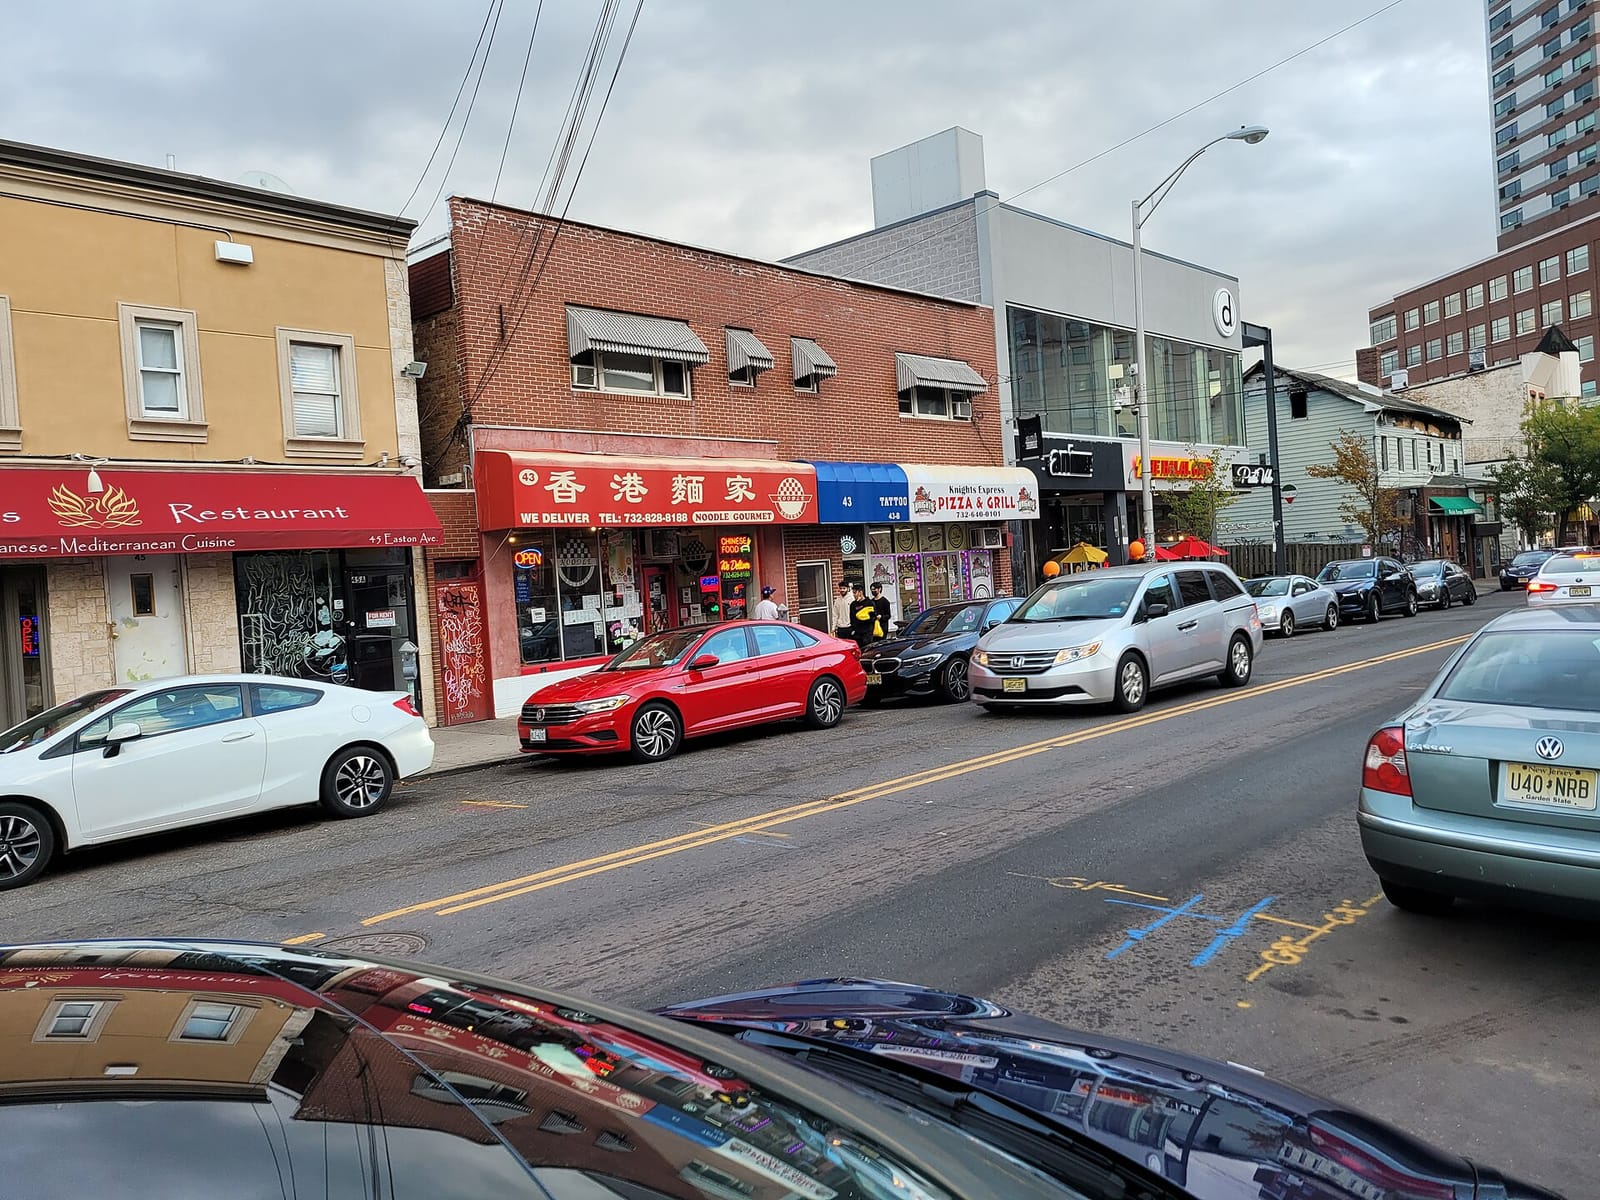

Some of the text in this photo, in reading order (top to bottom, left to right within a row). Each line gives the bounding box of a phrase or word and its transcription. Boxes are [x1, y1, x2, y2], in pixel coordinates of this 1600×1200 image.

[522, 473, 536, 482] 43
[543, 470, 756, 505] 香港麵家
[949, 485, 1005, 495] Knights Express
[842, 496, 853, 507] 43
[879, 496, 908, 507] TATTOO
[938, 496, 973, 510] PIZZA
[976, 496, 983, 509] &
[986, 496, 1016, 509] GRILL
[168, 502, 350, 525] Restaurant
[520, 511, 688, 524] WE DELIVER TEL: 732-828-8188
[695, 511, 773, 522] NOODLE GOURMET
[181, 534, 236, 551] Cuisine
[368, 532, 439, 545] 45 Easton Ave.
[721, 536, 747, 546] CHINESE
[721, 545, 740, 554] FOOD
[514, 552, 542, 565] OPEN
[22, 618, 33, 654] OPEN
[1528, 765, 1575, 777] New Jersey
[1511, 771, 1589, 799] U40 NRB
[1525, 793, 1572, 805] Garden State
